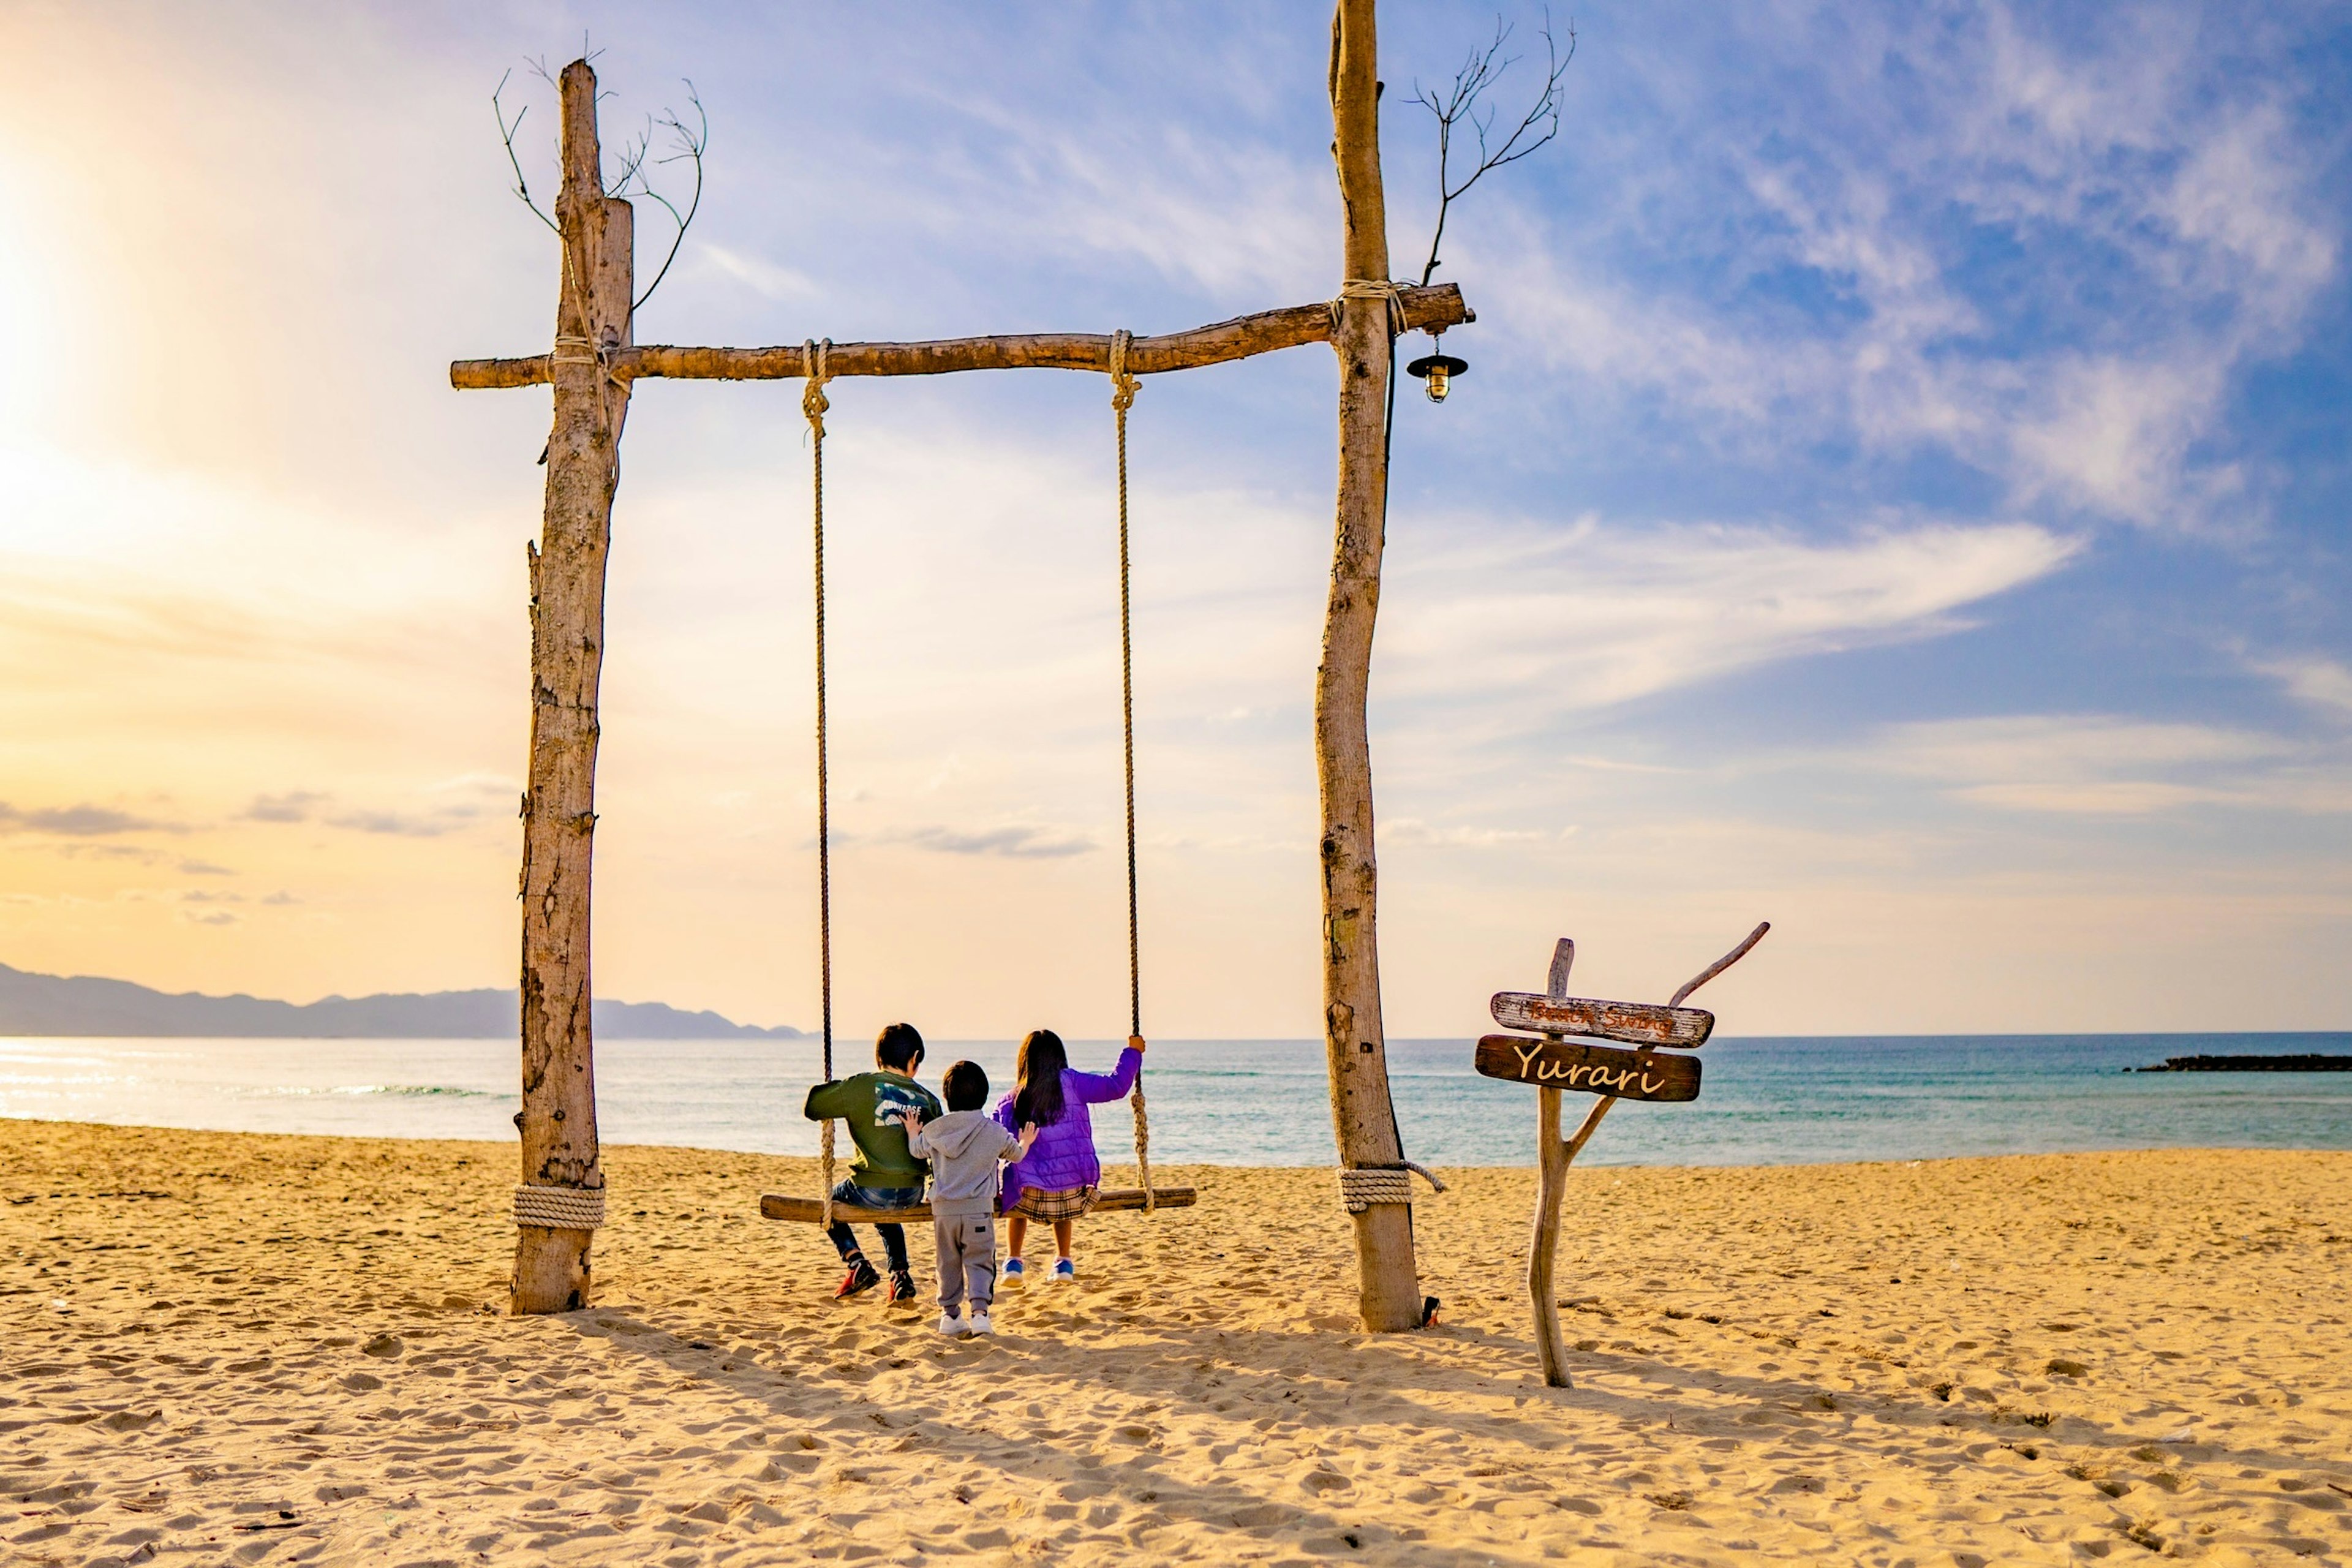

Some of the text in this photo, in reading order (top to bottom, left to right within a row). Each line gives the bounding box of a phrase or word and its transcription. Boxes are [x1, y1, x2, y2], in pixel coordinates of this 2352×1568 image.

[1531, 1001, 1672, 1038] Beach Swing
[1513, 1043, 1665, 1093] Yurari
